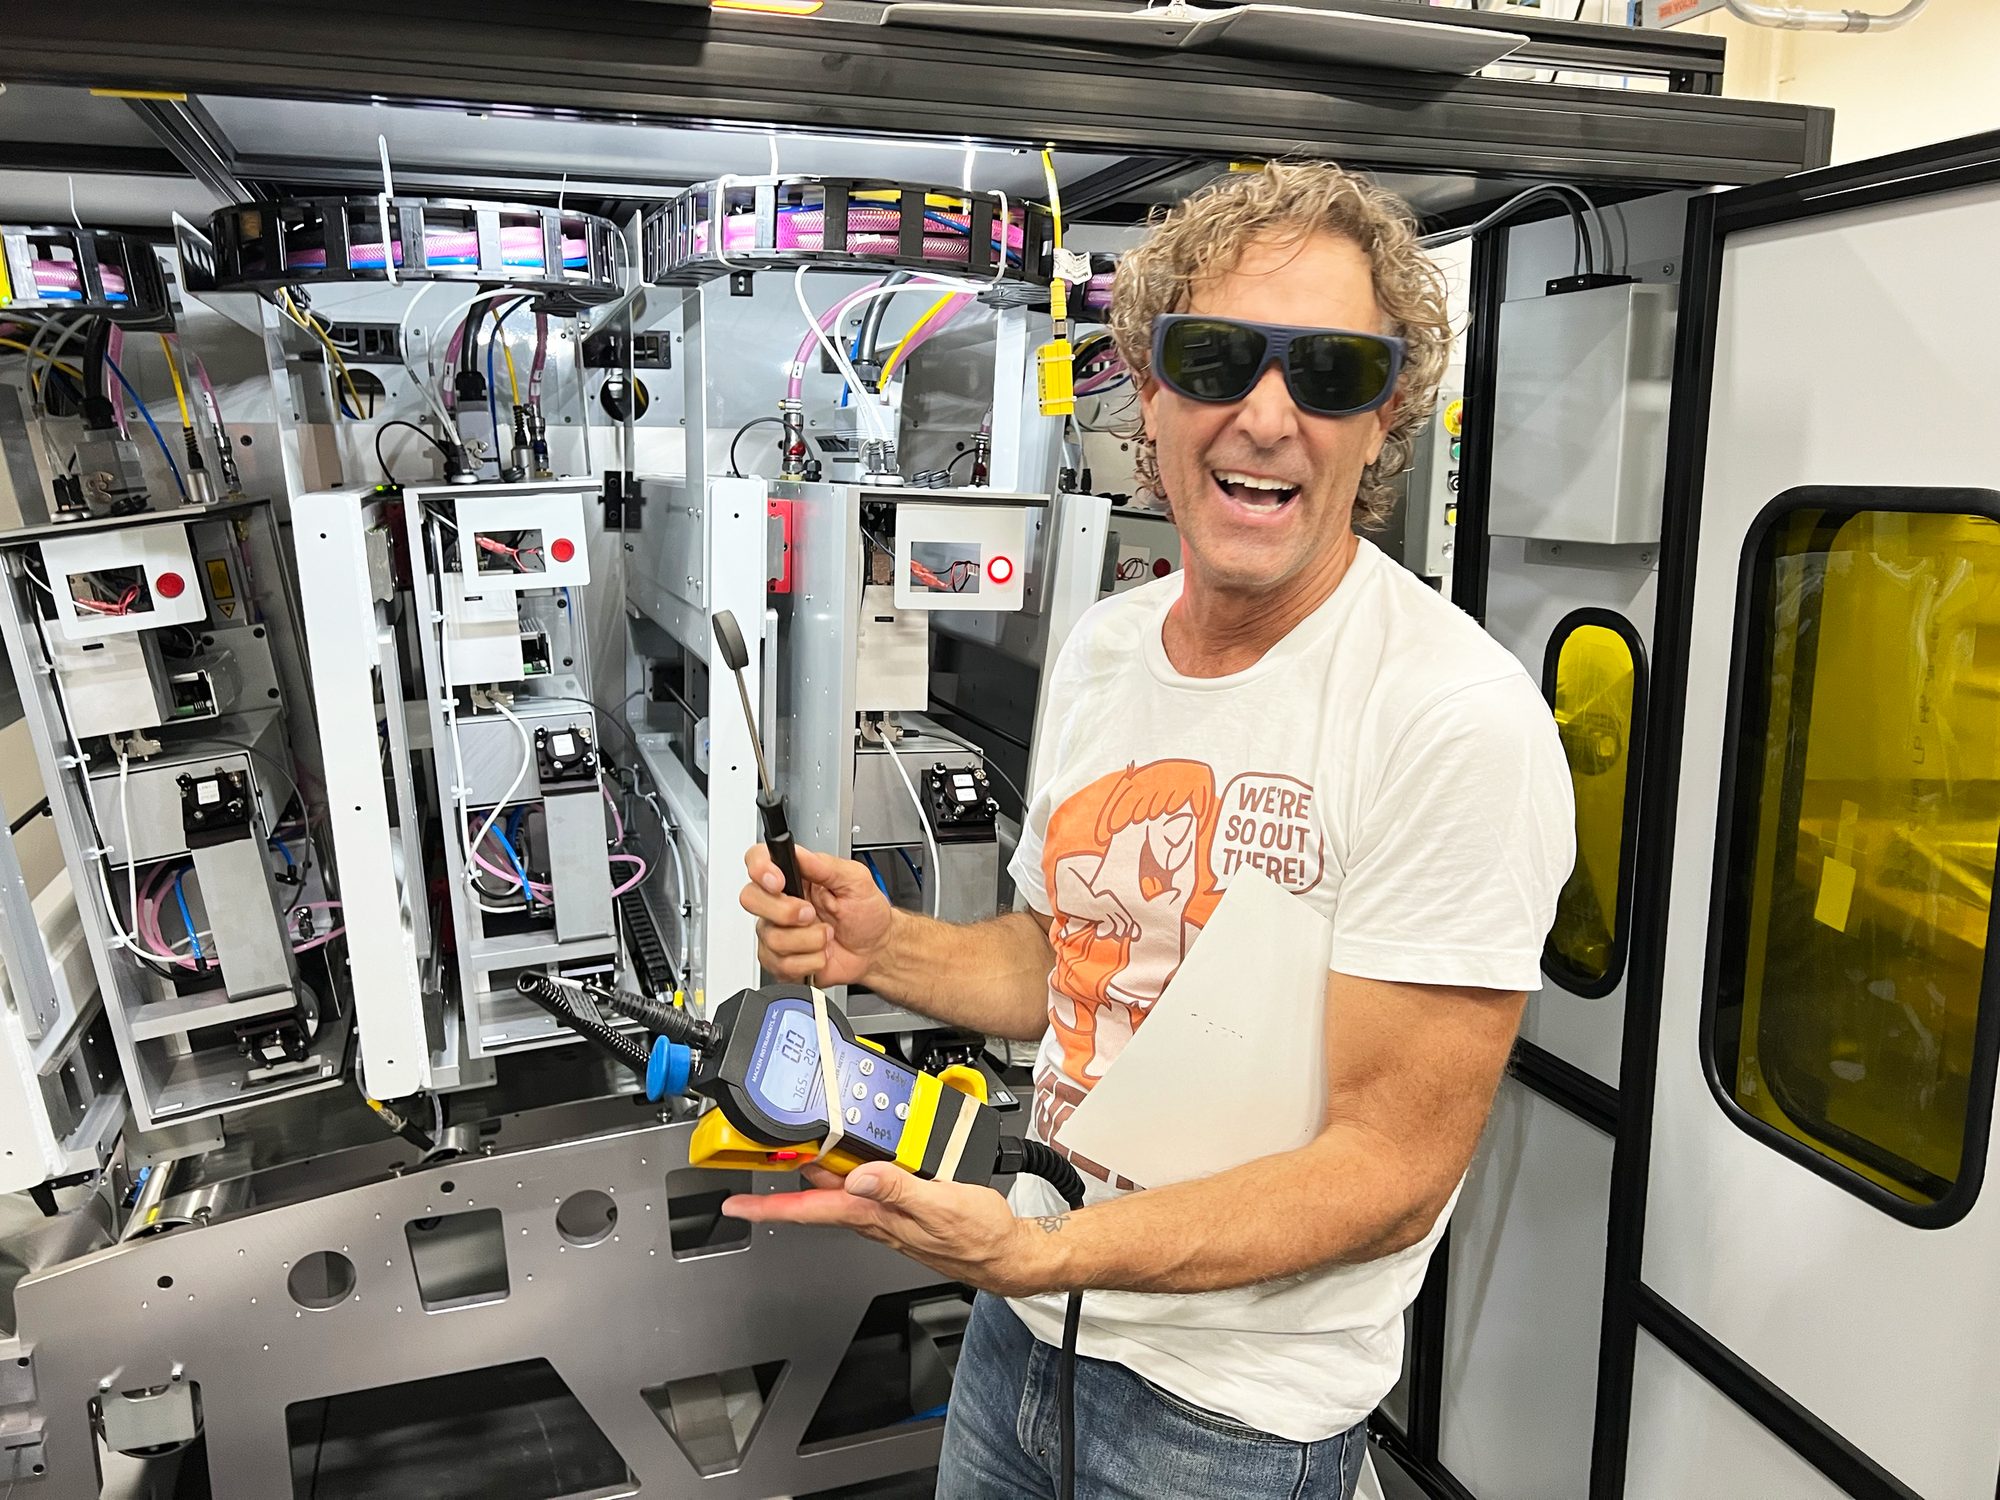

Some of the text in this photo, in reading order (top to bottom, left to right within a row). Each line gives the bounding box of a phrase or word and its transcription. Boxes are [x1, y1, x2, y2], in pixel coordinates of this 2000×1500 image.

[1239, 783, 1311, 820] WE'RE
[1225, 815, 1310, 853] SO OUT
[1223, 848, 1305, 886] THERE!
[781, 1029, 806, 1063] 0.0
[804, 1048, 816, 1066] 20
[751, 1057, 763, 1082] MACKEN
[866, 1121, 892, 1140] Apps
